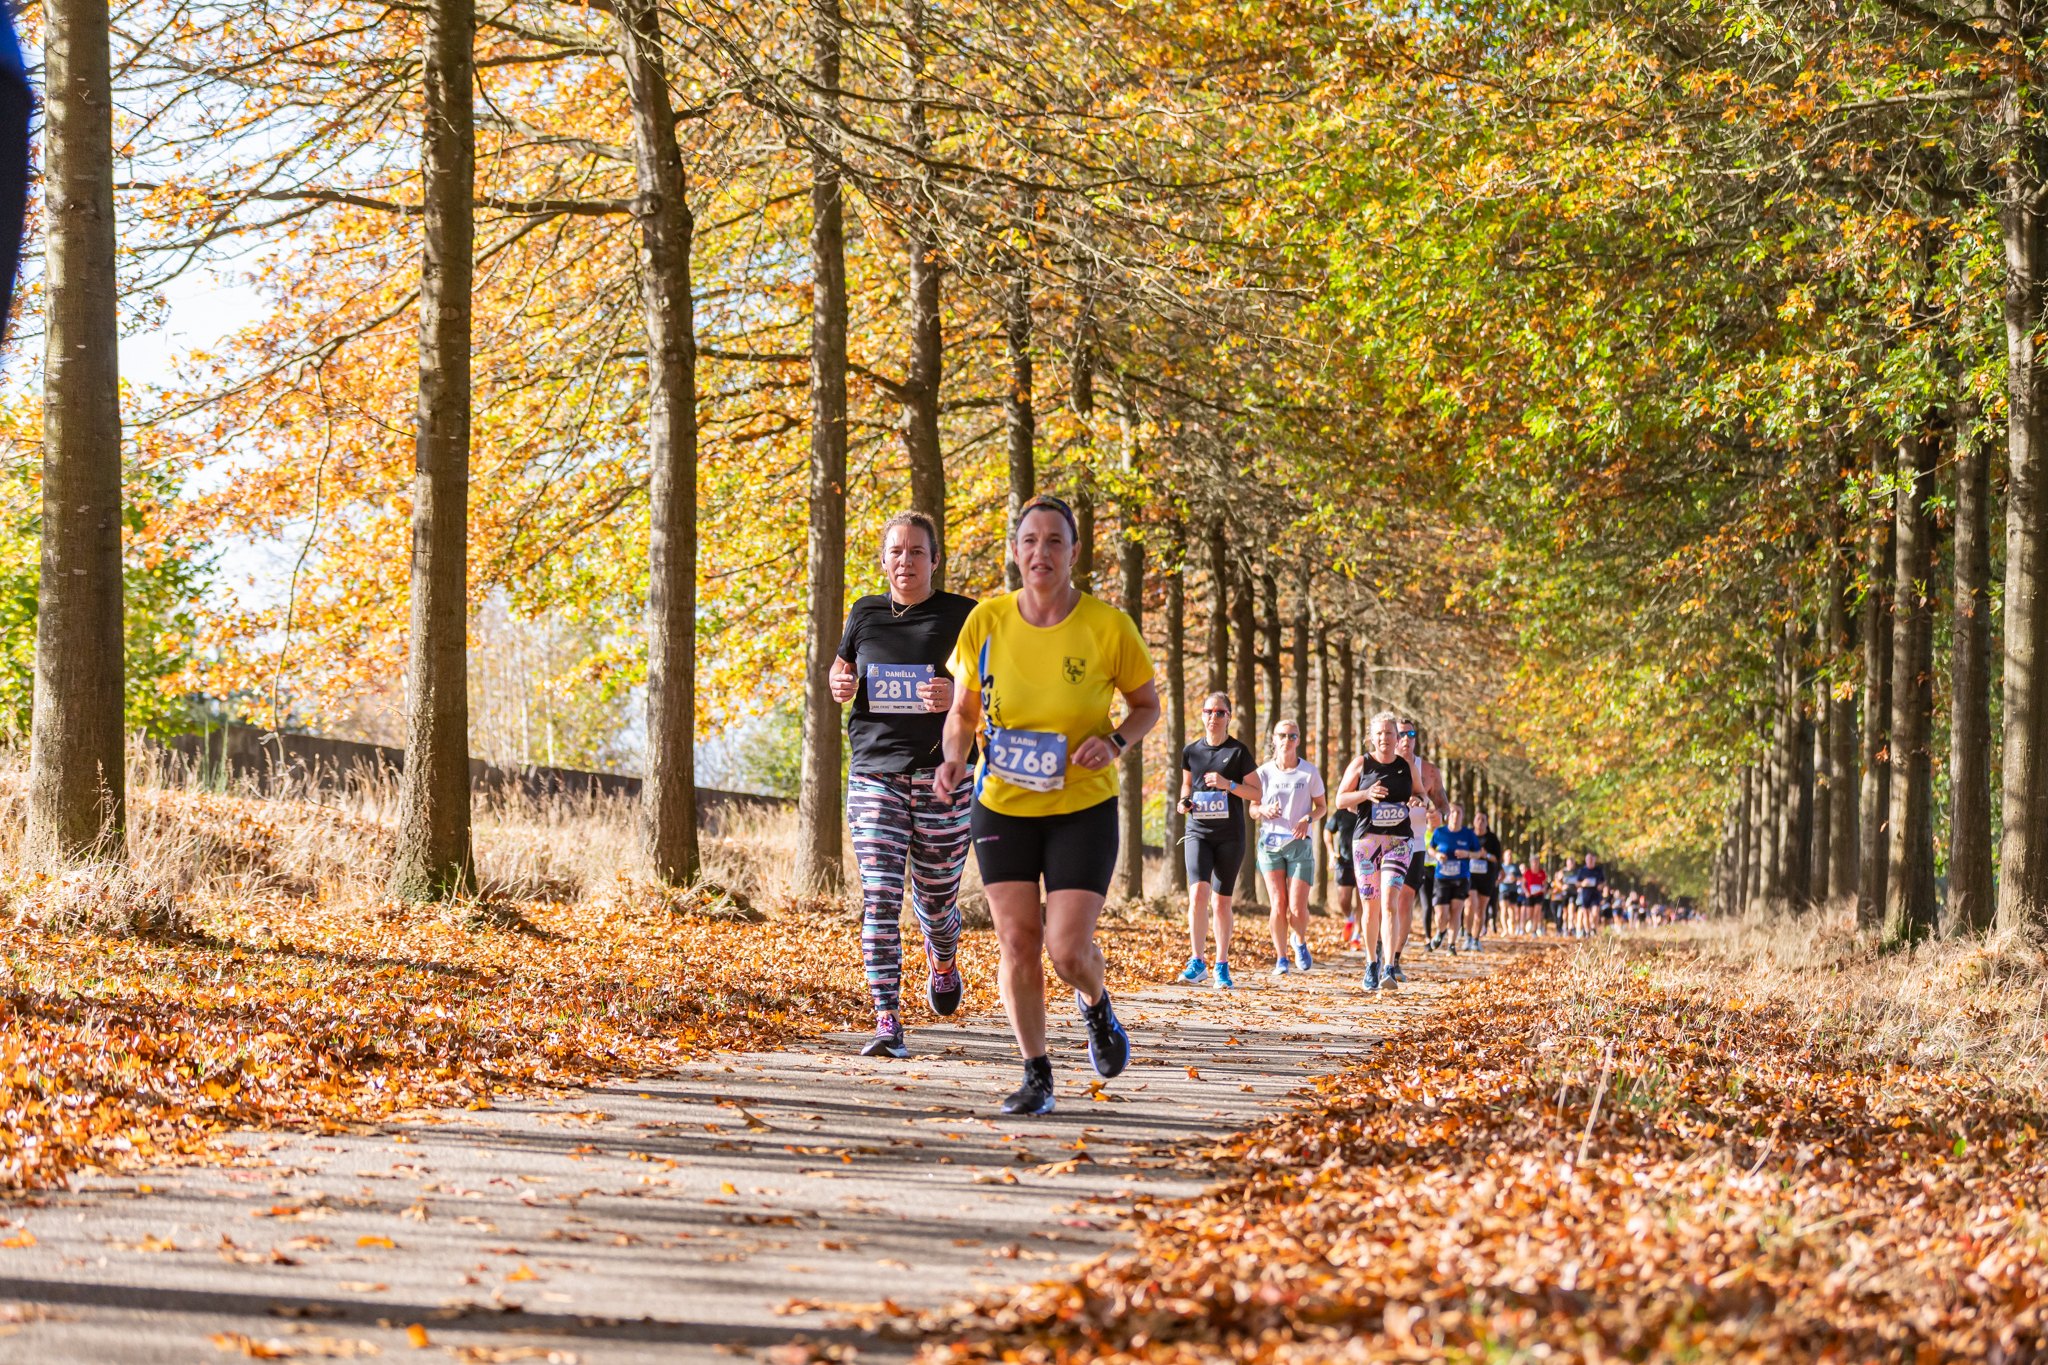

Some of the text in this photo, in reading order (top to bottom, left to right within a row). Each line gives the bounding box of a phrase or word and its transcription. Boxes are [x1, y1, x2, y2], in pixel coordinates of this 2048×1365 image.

[885, 669, 917, 678] DANIËLLA
[1010, 736, 1038, 747] KARIN
[993, 744, 1058, 776] 2768
[1195, 800, 1225, 812] 3160
[1375, 808, 1405, 820] 2026
